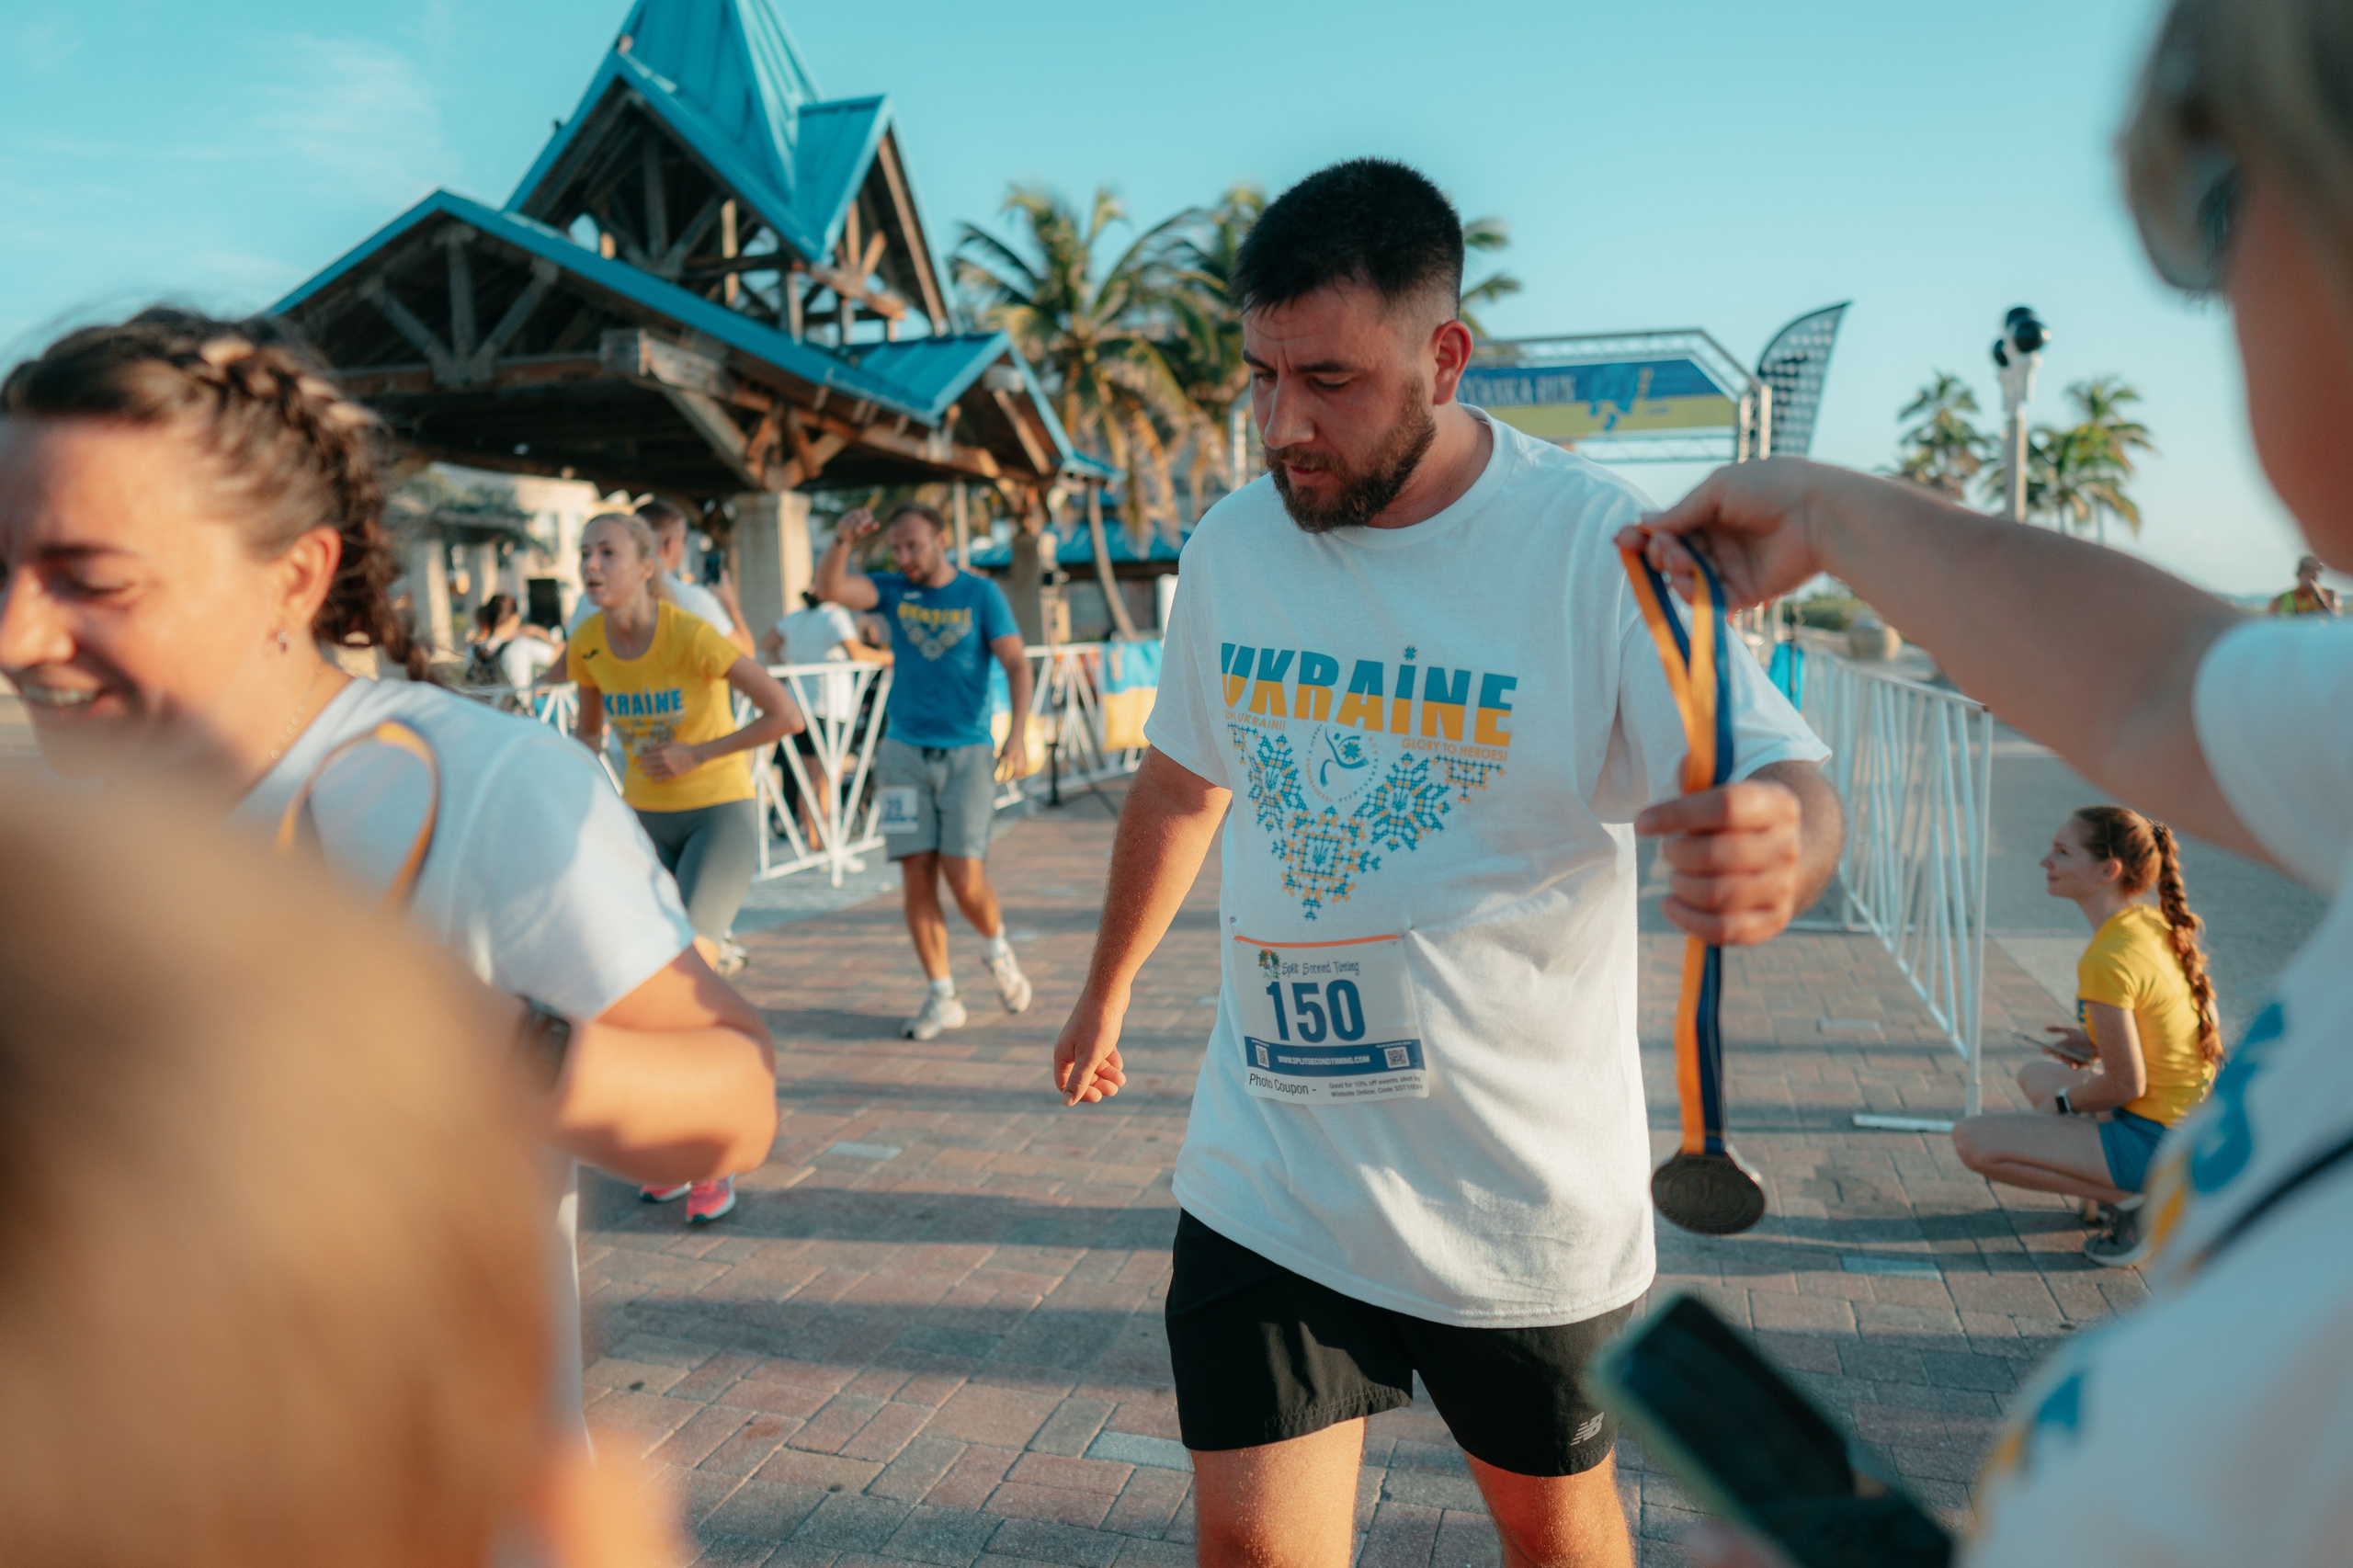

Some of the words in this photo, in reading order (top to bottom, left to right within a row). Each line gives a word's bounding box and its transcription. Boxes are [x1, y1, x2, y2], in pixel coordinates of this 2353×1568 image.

[602, 687, 684, 716] KRAINE
[1402, 738, 1439, 752] GLORY
[1442, 742, 1457, 755] TO
[1460, 745, 1508, 762] HEROES!
[1282, 961, 1299, 978] Split
[1302, 961, 1332, 975] Second
[1333, 961, 1360, 977] Timing
[1266, 979, 1366, 1043] 150
[1249, 1073, 1273, 1089] Photo
[1274, 1078, 1310, 1096] Coupon
[1378, 1085, 1393, 1094] Code
[1379, 1077, 1398, 1085] events
